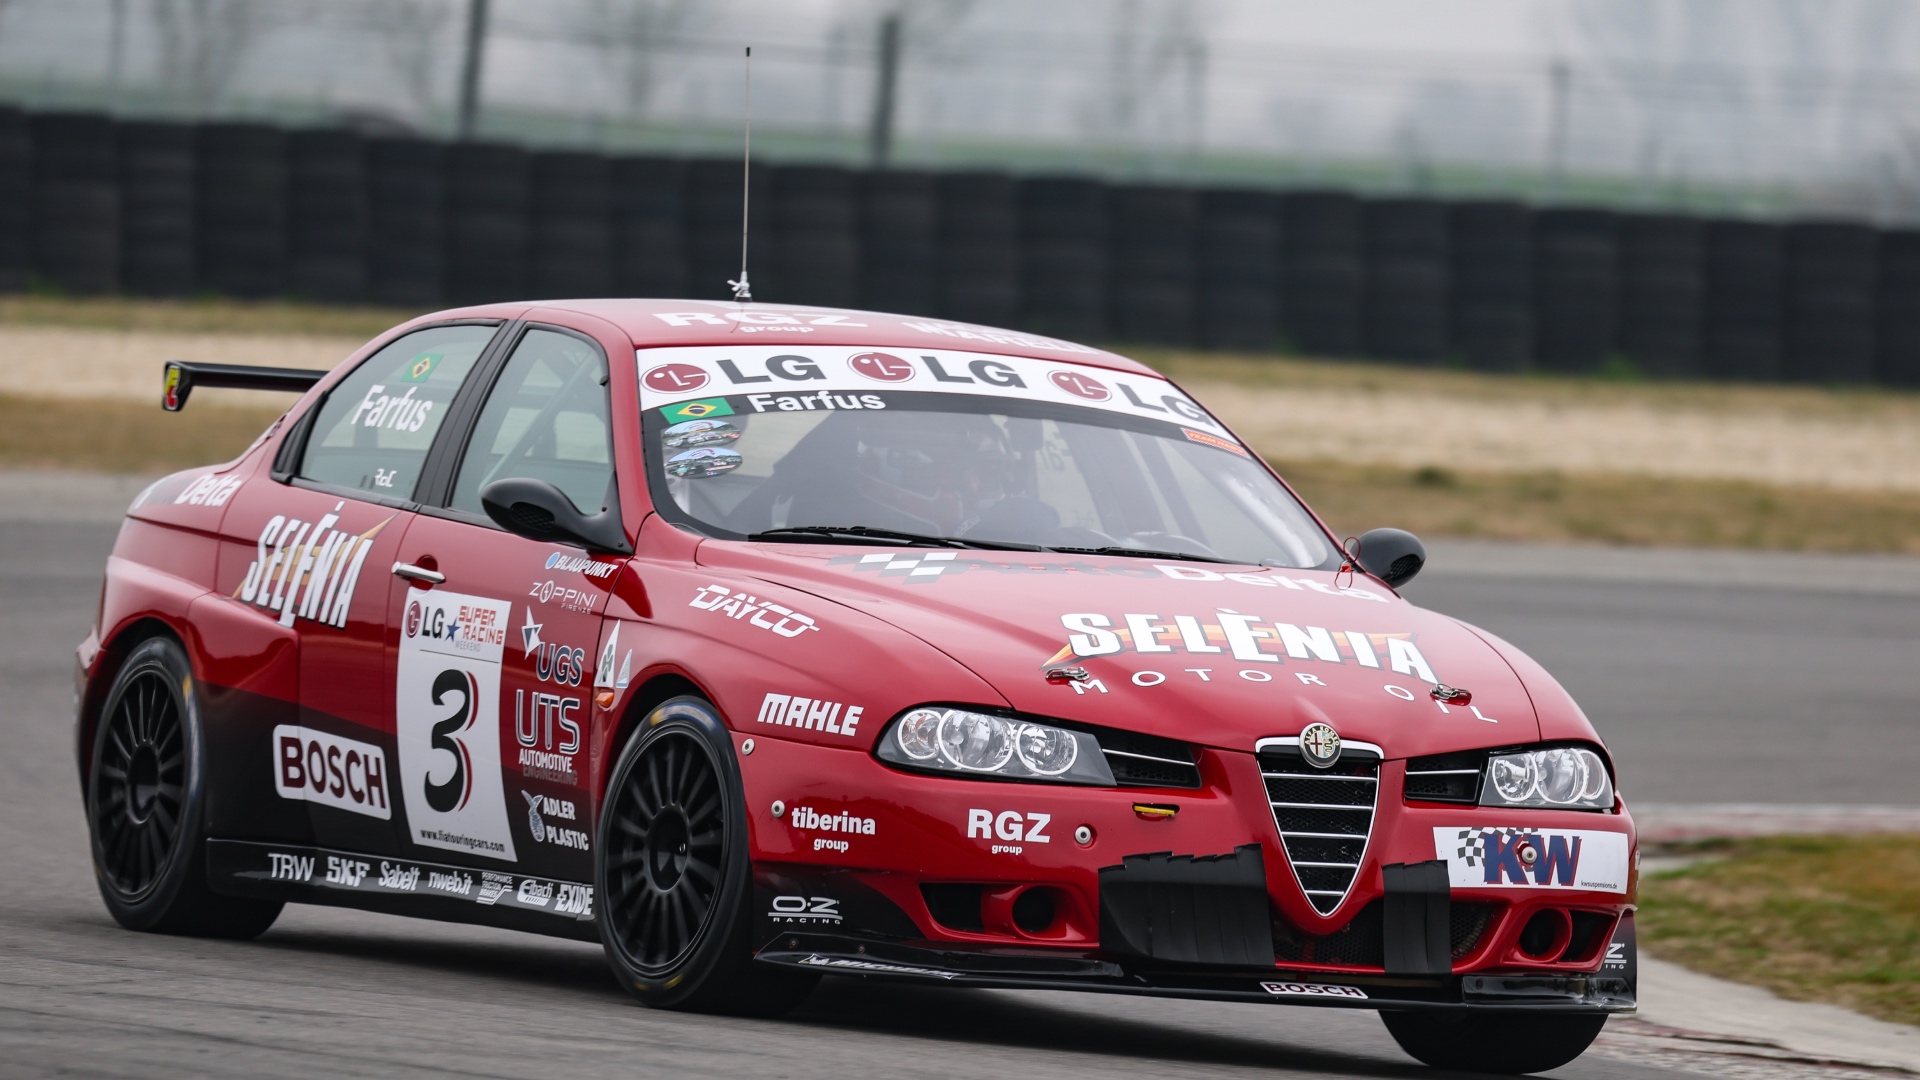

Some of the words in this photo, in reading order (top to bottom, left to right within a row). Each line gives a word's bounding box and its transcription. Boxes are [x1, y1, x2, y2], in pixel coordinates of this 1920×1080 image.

[652, 312, 868, 337] RGZ
[740, 326, 814, 343] group
[716, 355, 827, 385] LG
[920, 356, 1028, 389] LG
[351, 384, 433, 432] Farfus
[747, 391, 886, 413] Farfus
[1116, 383, 1217, 428] LG
[174, 474, 243, 506] Delta
[554, 555, 618, 578] BLAUPUNKT
[529, 580, 598, 608] ZOPPINI
[422, 606, 444, 639] LG
[459, 605, 497, 627] SUPER
[689, 584, 820, 638] DAYCO
[454, 640, 481, 652] WEEKEND
[462, 624, 504, 646] RACING
[536, 641, 585, 687] UGS
[1070, 668, 1328, 695] MOTOR
[1384, 684, 1498, 724] OIL
[516, 688, 580, 755] UTS
[757, 692, 864, 736] MAHLE
[424, 668, 479, 814] 3
[280, 735, 387, 811] BOSCH
[519, 748, 573, 774] AUTOMOTIVE
[543, 796, 576, 821] ADLER
[792, 806, 876, 835] tiberina
[545, 825, 589, 851] PLASTIC
[967, 808, 1051, 843] RGZ
[813, 837, 849, 853] group
[991, 843, 1023, 855] group
[267, 852, 315, 881] TRW
[325, 855, 370, 887] SKF
[1484, 833, 1582, 887] KW
[378, 861, 420, 891] Sabelt
[517, 879, 554, 902] Eibach
[1581, 880, 1618, 890] kwsuspensions.de
[554, 883, 594, 916] EXIDE
[773, 917, 841, 925] RACING
[1263, 983, 1364, 997] BOSCH
